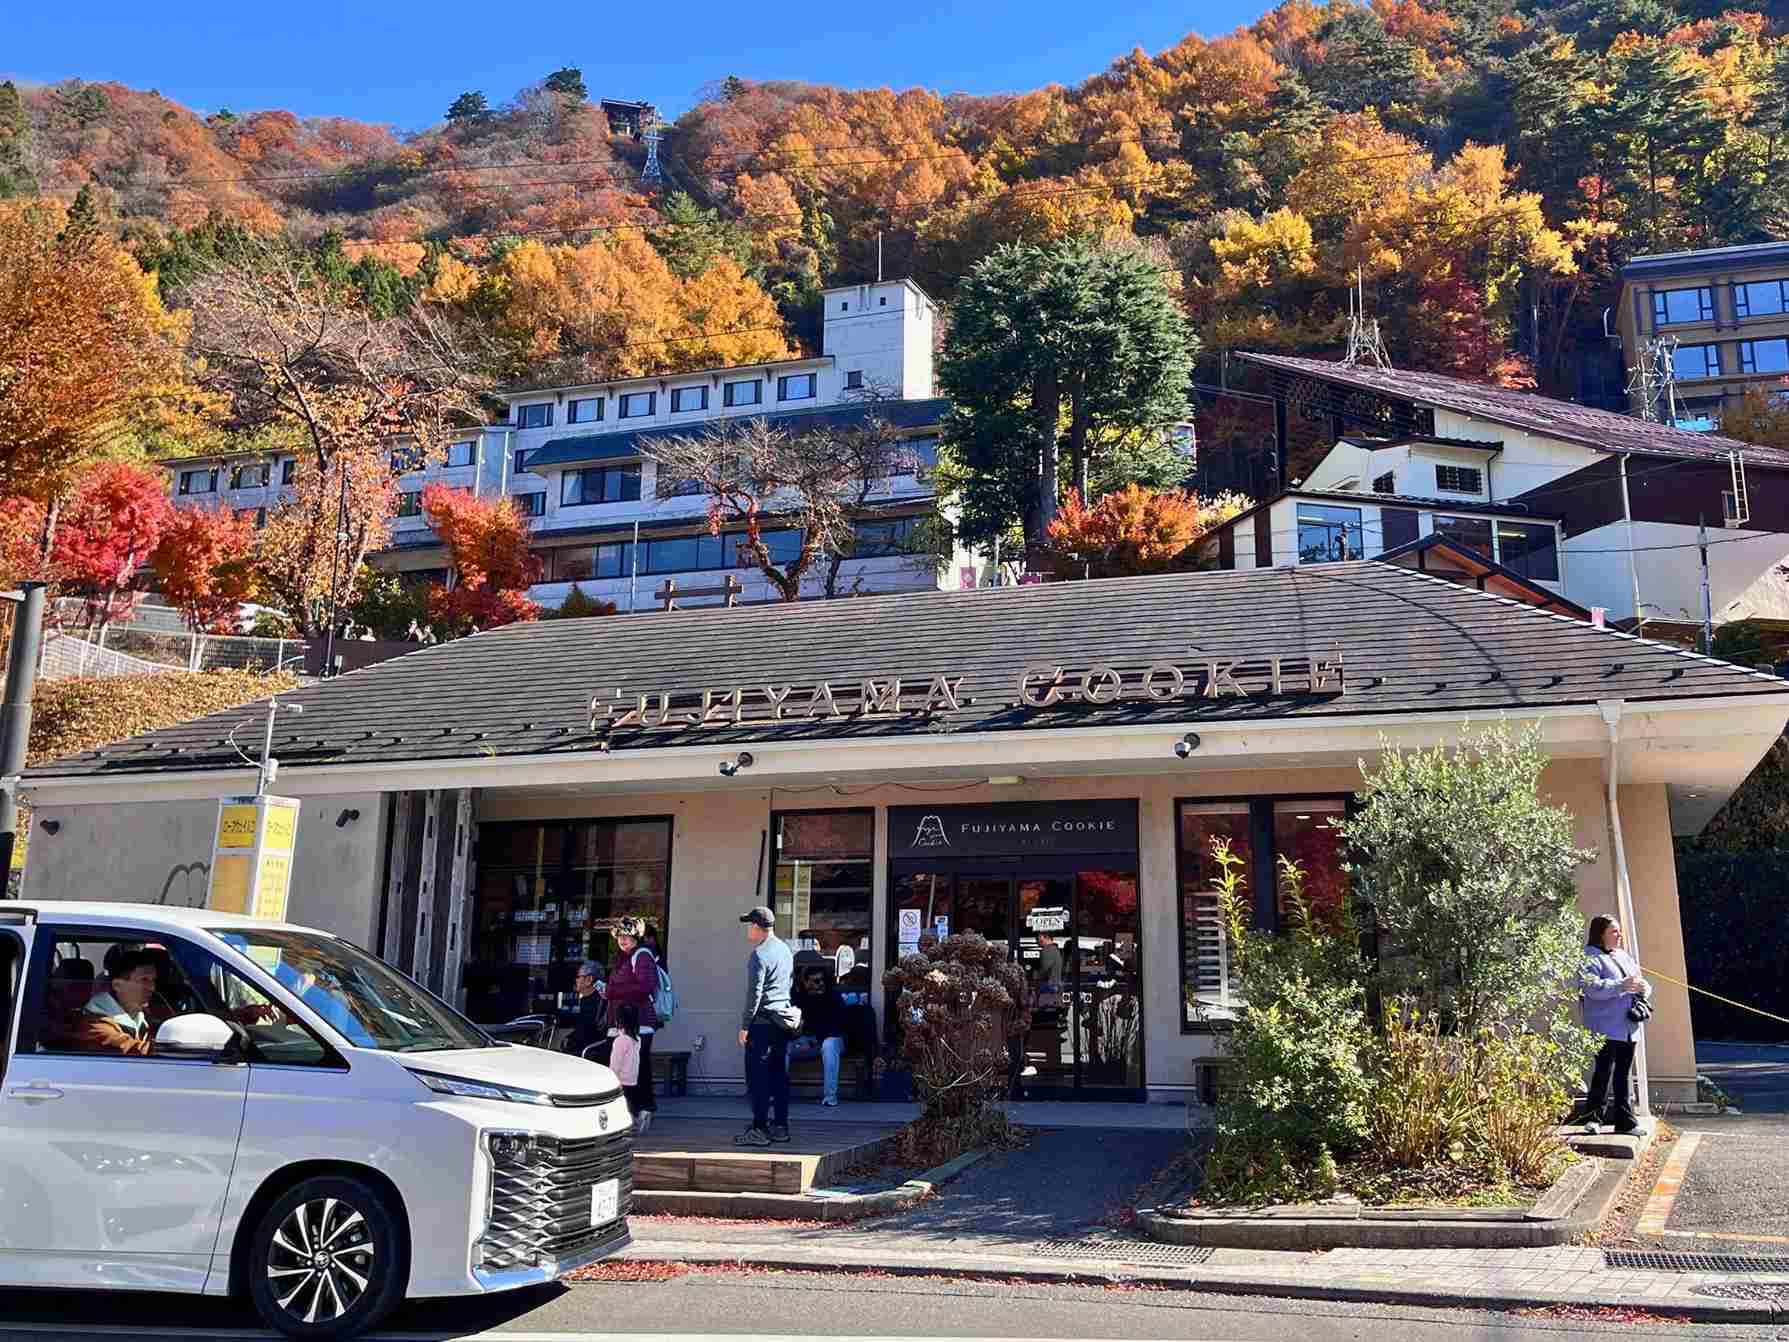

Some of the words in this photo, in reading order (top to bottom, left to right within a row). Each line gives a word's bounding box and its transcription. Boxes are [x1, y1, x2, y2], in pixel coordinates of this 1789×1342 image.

[588, 677, 964, 730] FUJIYAMA
[1017, 653, 1344, 707] COOKIE
[960, 823, 1041, 834] FUJIYAMA
[1051, 820, 1115, 832] COOKIE
